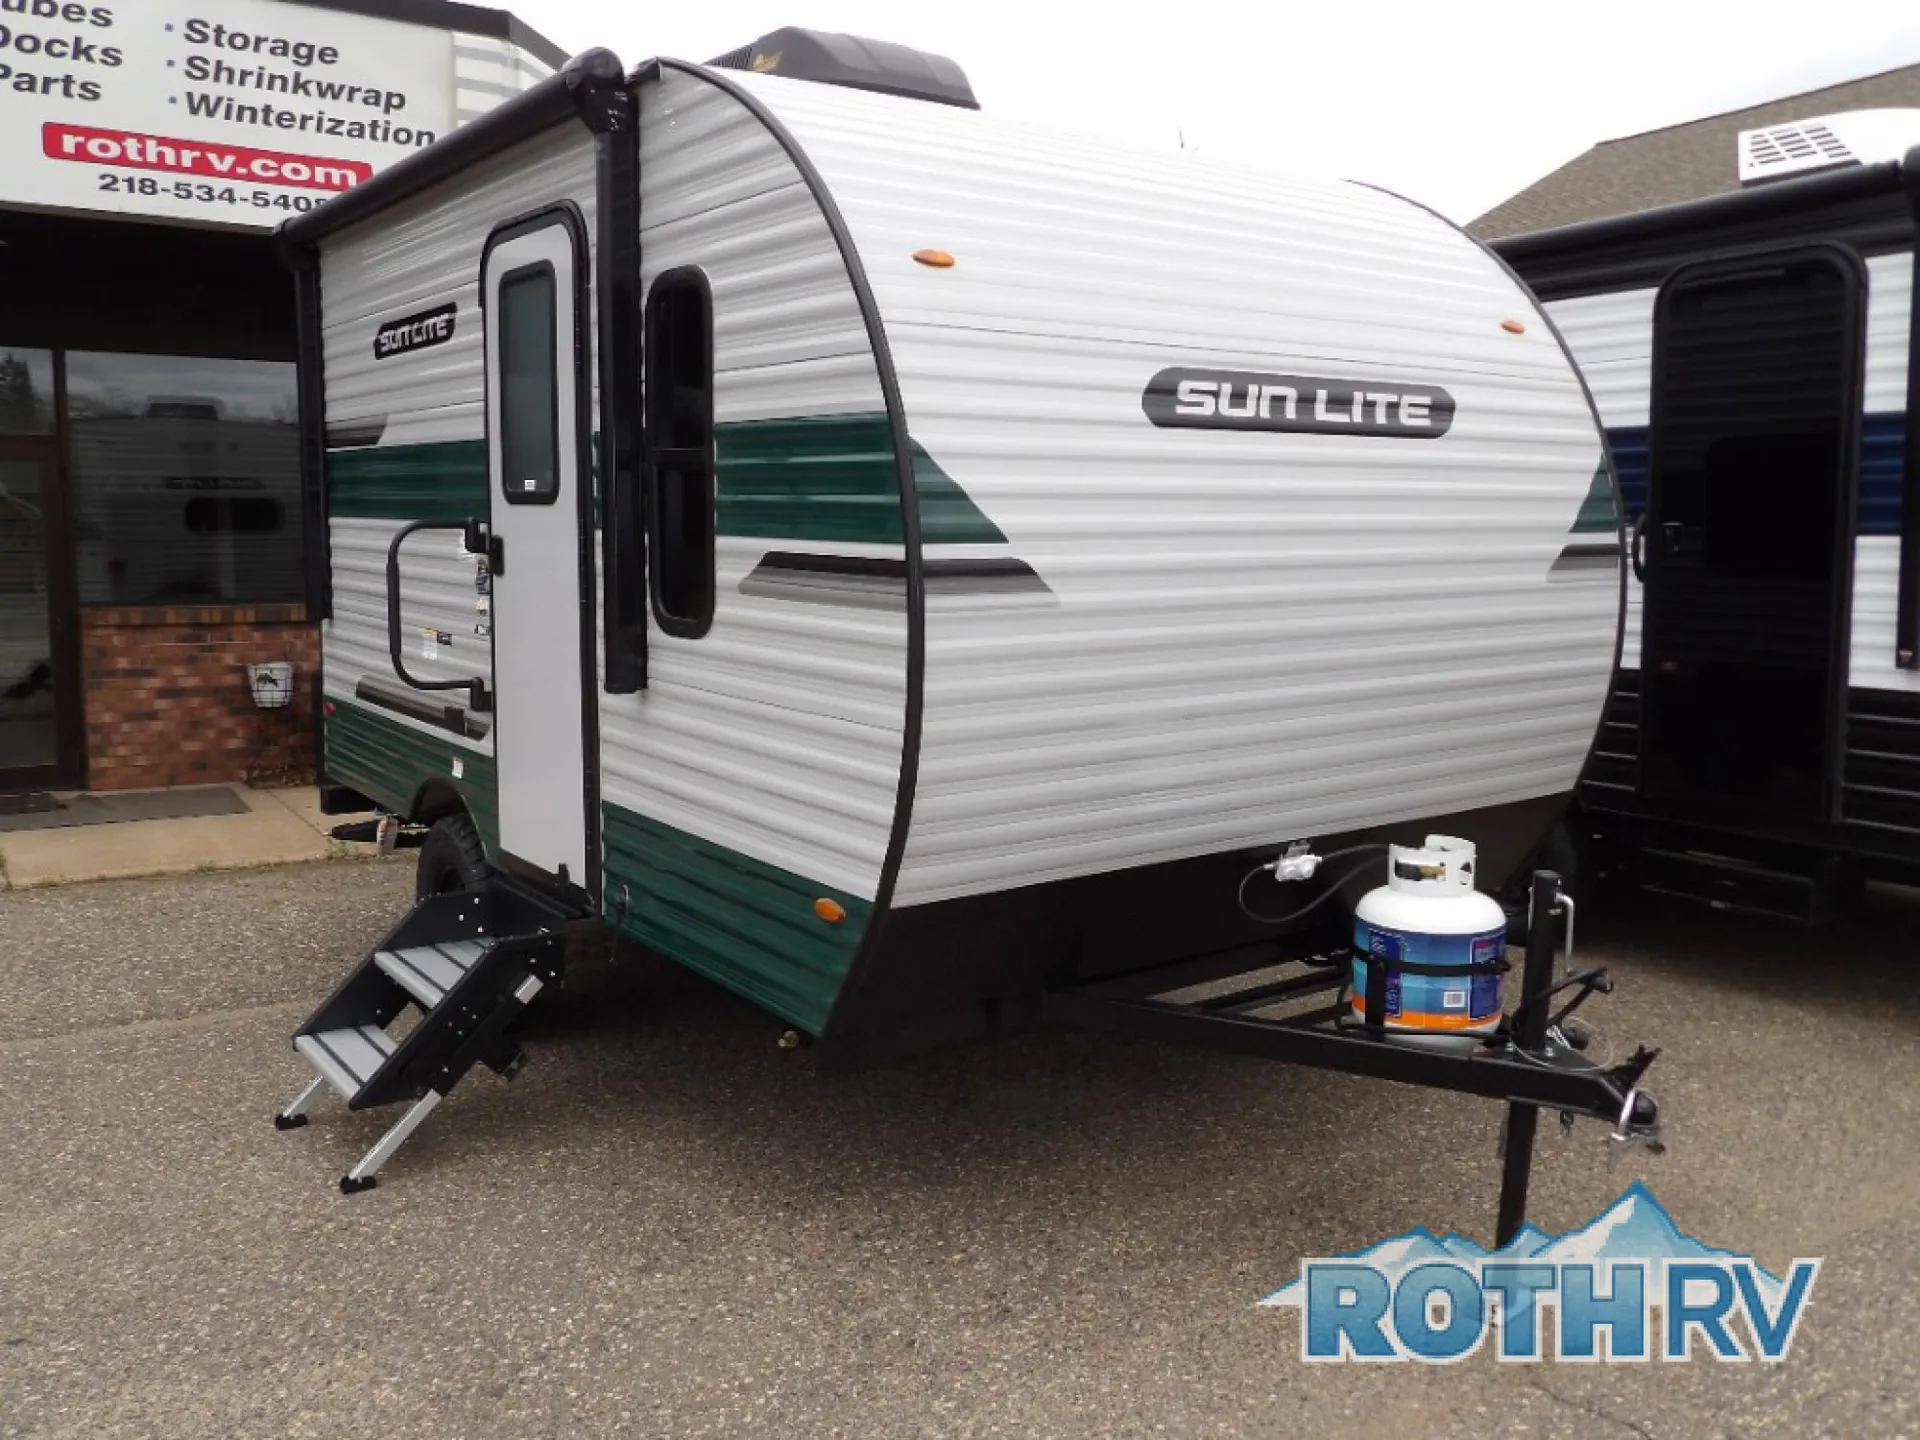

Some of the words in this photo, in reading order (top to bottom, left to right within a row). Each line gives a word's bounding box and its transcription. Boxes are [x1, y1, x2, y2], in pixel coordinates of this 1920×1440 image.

[184, 18, 340, 67] Storage
[184, 55, 407, 115] Shrinkwrap
[185, 91, 436, 148] Winterization
[61, 133, 358, 187] rothrv.com
[411, 312, 449, 344] LITE
[1174, 379, 1299, 420] SUN
[1313, 388, 1432, 427] LITE
